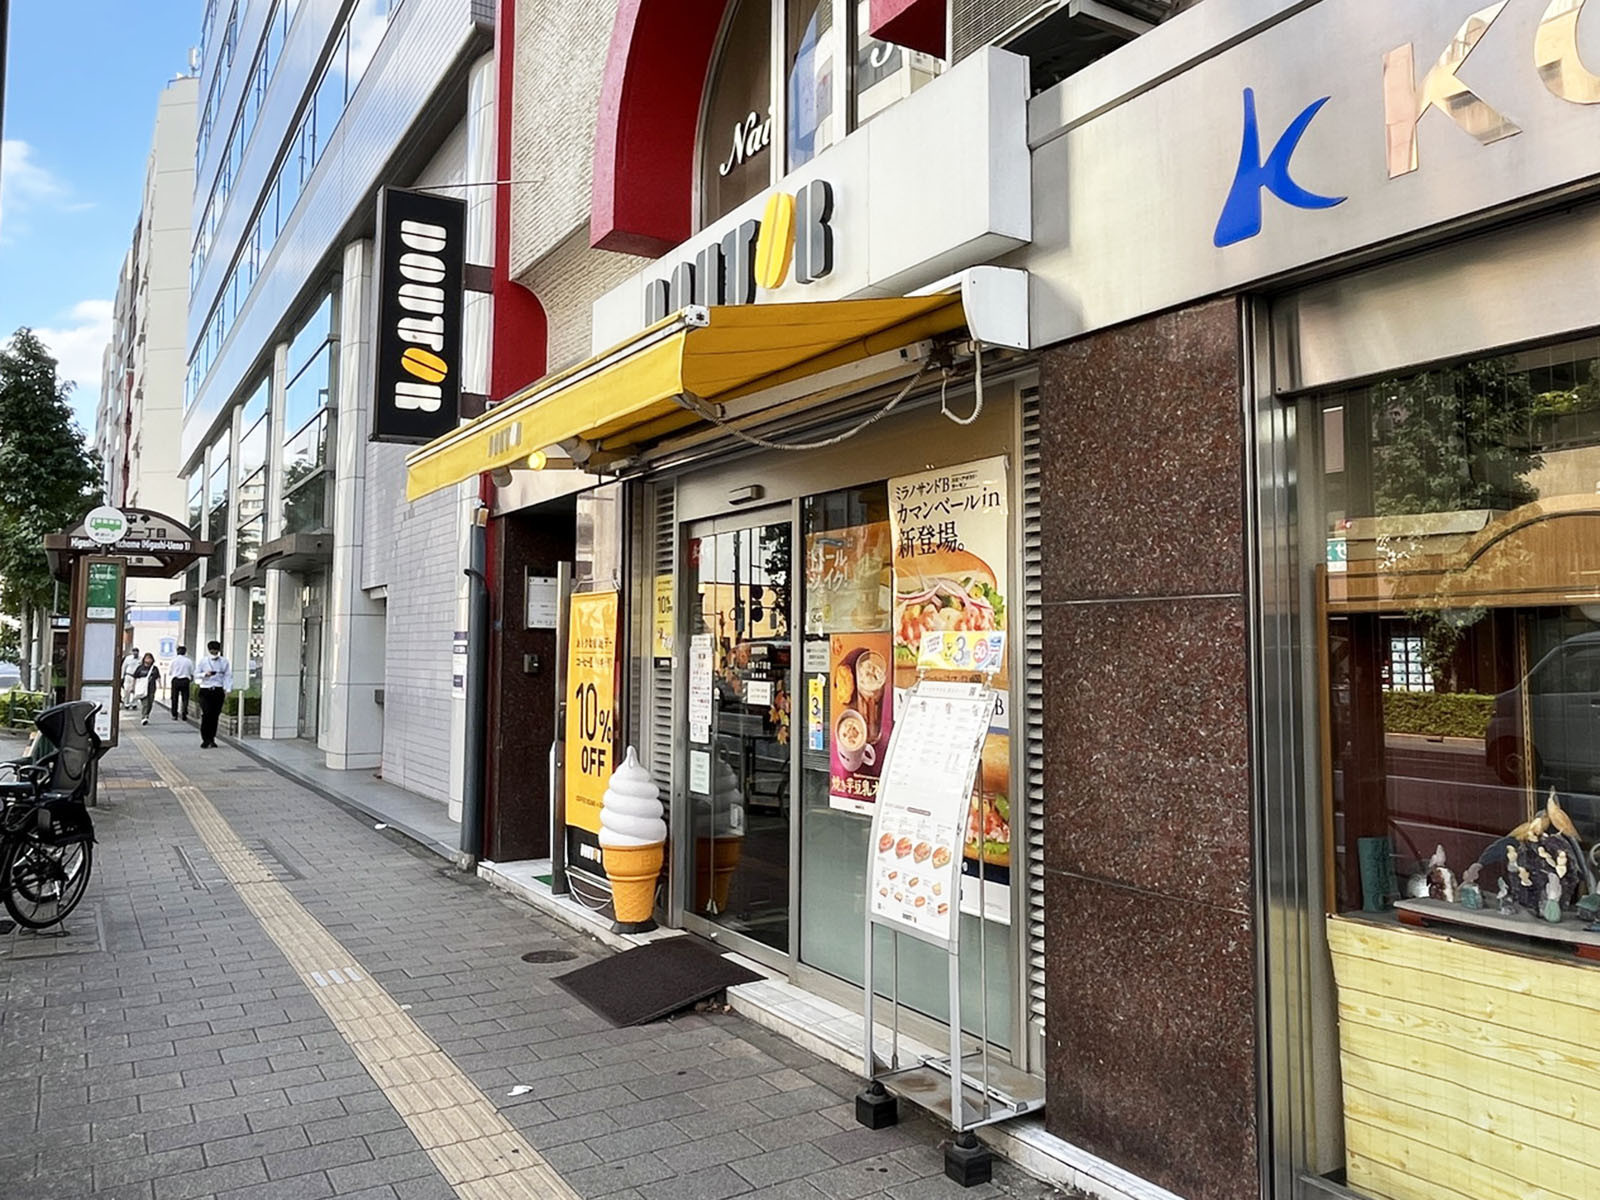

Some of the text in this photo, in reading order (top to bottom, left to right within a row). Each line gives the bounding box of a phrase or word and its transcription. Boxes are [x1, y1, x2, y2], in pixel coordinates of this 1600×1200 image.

[644, 179, 834, 328] DOUTOR
[394, 219, 449, 413] DOUTOR
[899, 521, 965, 559] 新登場。
[575, 682, 612, 744] 10%
[581, 745, 607, 777] OFF
